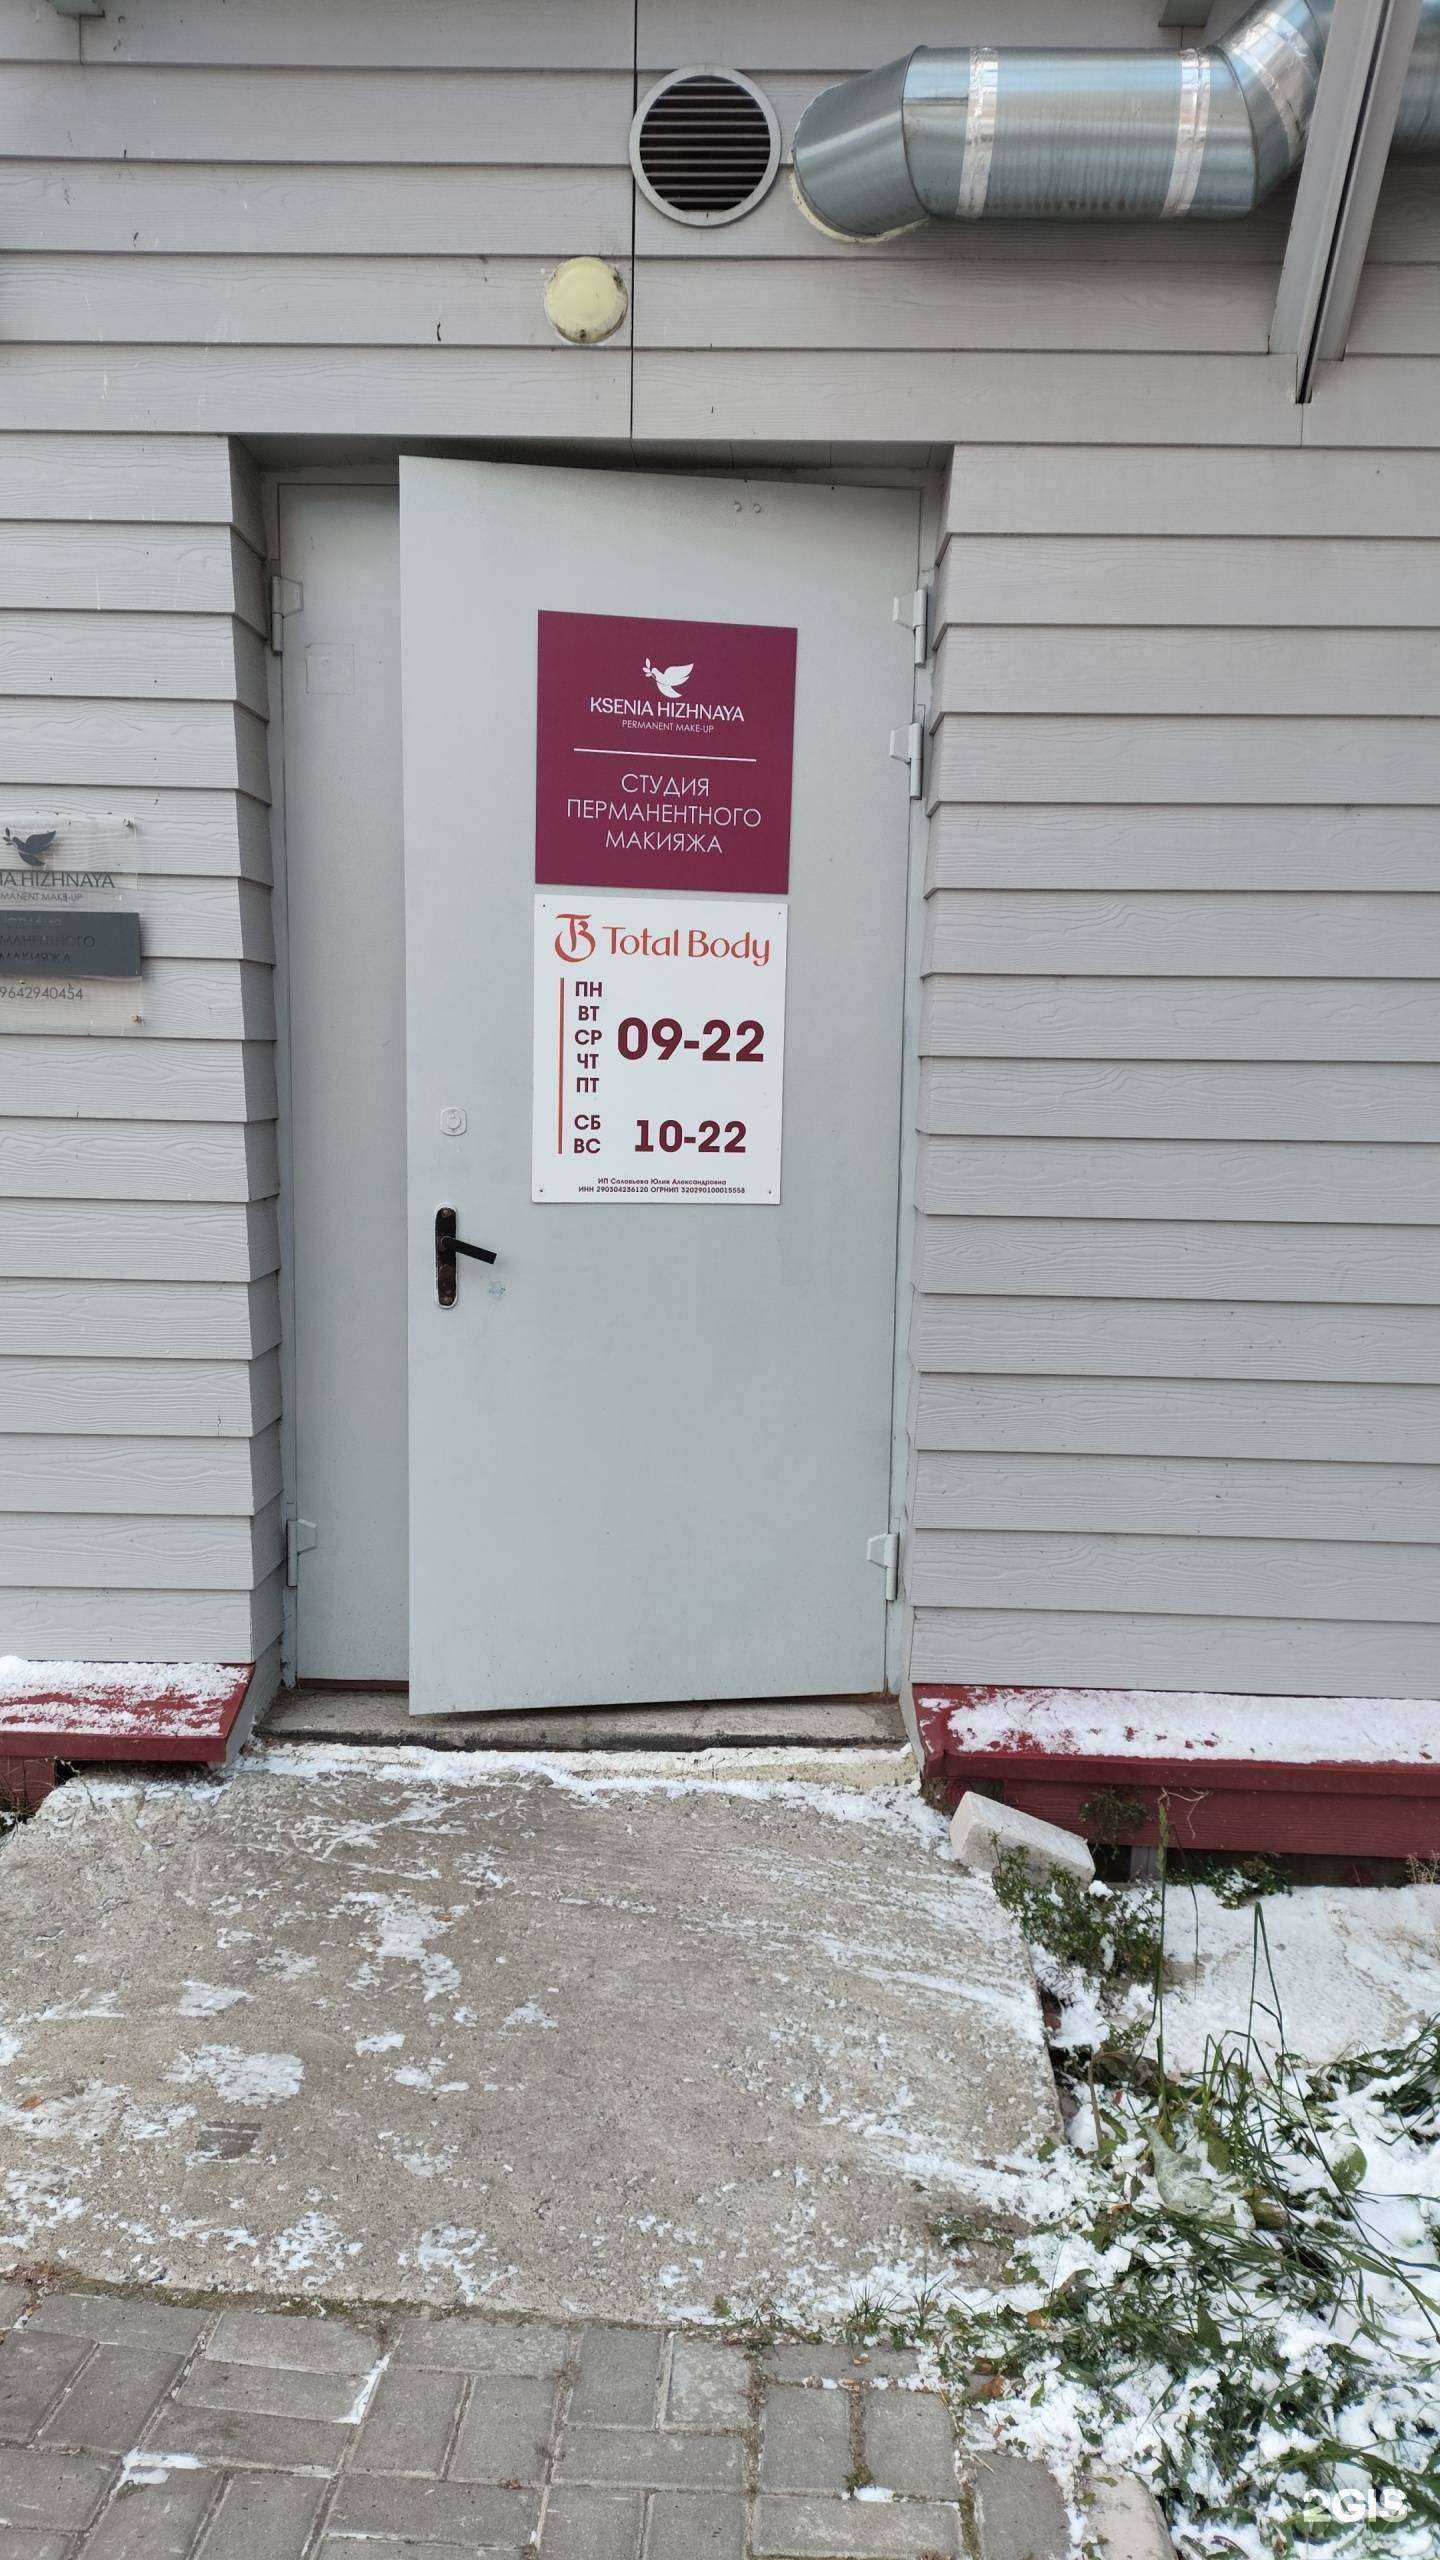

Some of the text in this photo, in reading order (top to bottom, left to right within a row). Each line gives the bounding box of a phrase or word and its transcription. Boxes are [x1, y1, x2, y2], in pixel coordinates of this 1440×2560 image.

[590, 697, 745, 721] KSENIA HIZHNAYA
[622, 719, 714, 733] PERMANENT MAKE-UP
[621, 773, 709, 797] СТУДИЯ
[567, 799, 761, 827] ПЕРМАНЕНТНОГО
[605, 830, 723, 853] МАКИЯЖА
[21, 871, 115, 888] HIZHNAYA
[602, 926, 679, 957] Total
[688, 929, 770, 967] Body
[575, 981, 603, 998] ПН
[578, 1005, 600, 1021] ВТ
[574, 1029, 602, 1046] СР
[617, 1017, 765, 1062] 09-22
[577, 1053, 599, 1069] ЧТ
[576, 1077, 599, 1093] ПТ
[574, 1114, 601, 1131] СБ
[634, 1119, 747, 1154] 10-22
[573, 1137, 601, 1154] ВС
[672, 1178, 727, 1187] Александровна
